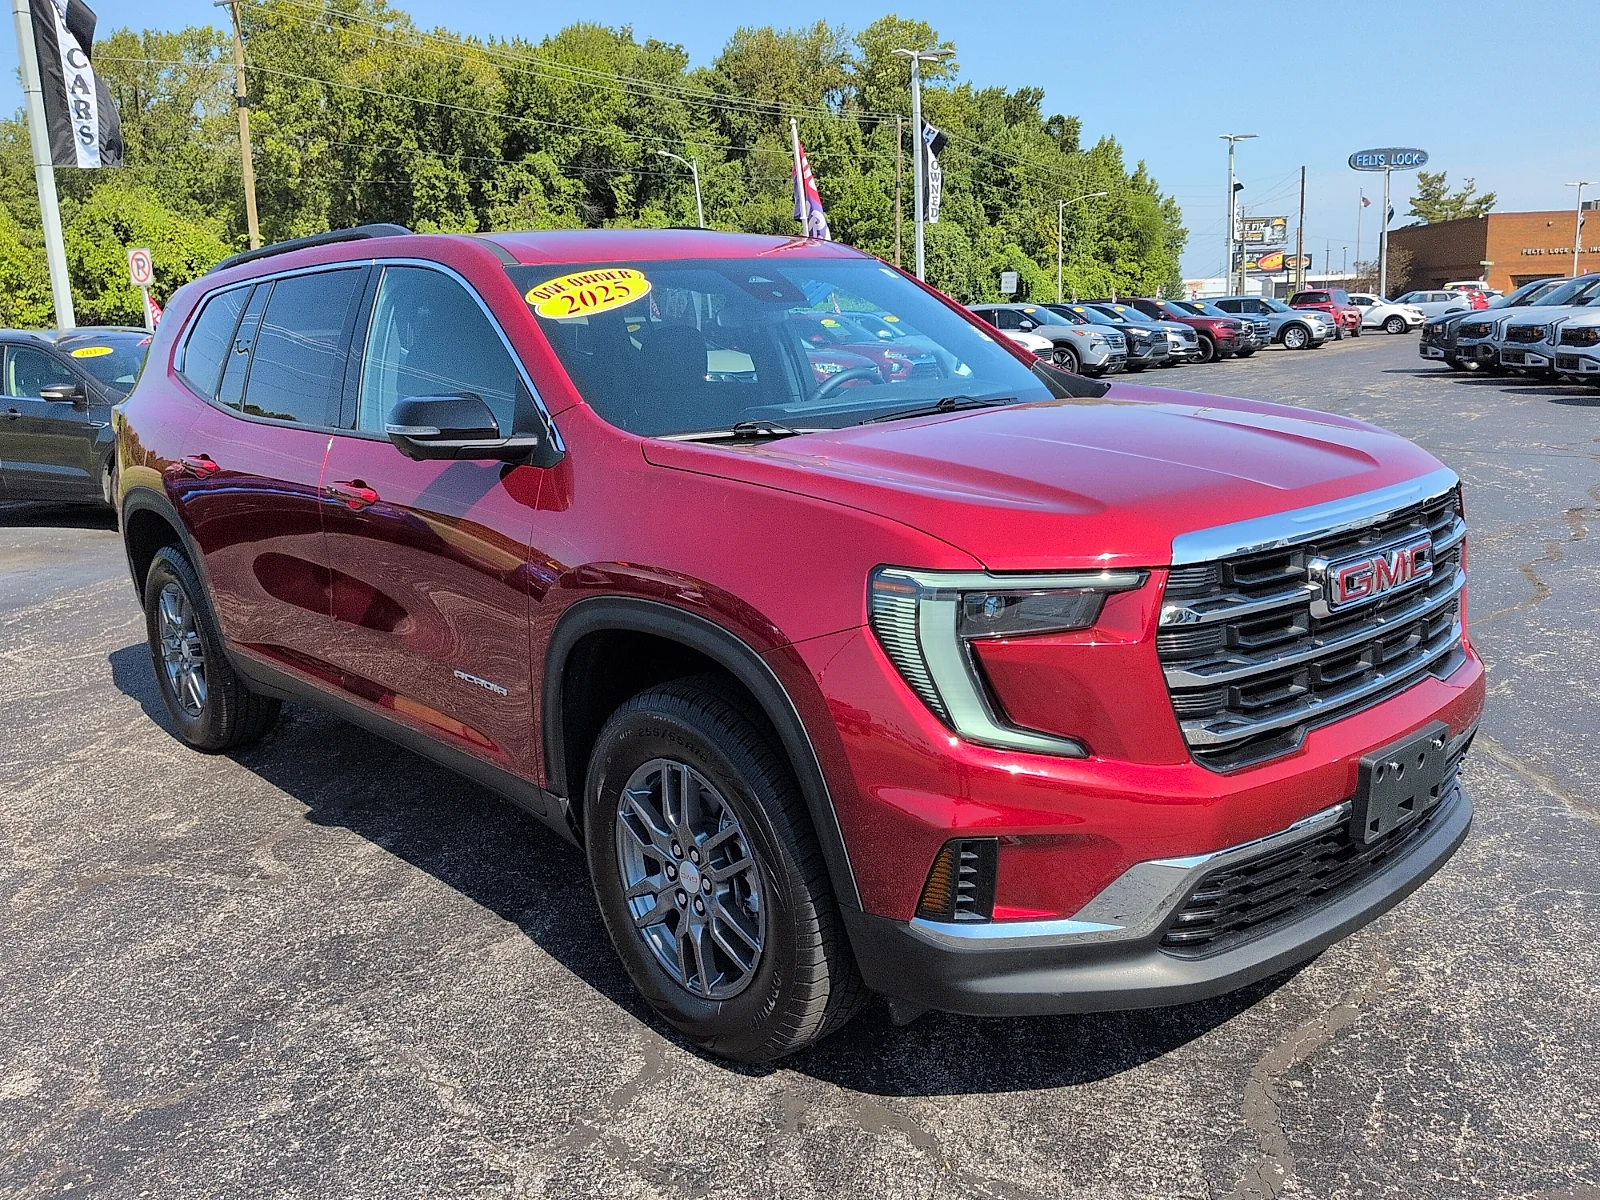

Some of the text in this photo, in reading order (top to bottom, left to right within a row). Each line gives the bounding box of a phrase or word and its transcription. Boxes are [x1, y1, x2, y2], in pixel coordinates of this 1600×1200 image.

[66, 47, 95, 146] CARS
[1356, 153, 1420, 166] FELTS LOCK
[930, 160, 941, 218] OWNED
[1252, 223, 1265, 231] FIX
[533, 270, 632, 300] ONE OWNER
[560, 281, 630, 314] 2025
[1338, 540, 1432, 602] GMC
[453, 669, 508, 697] ACADIA
